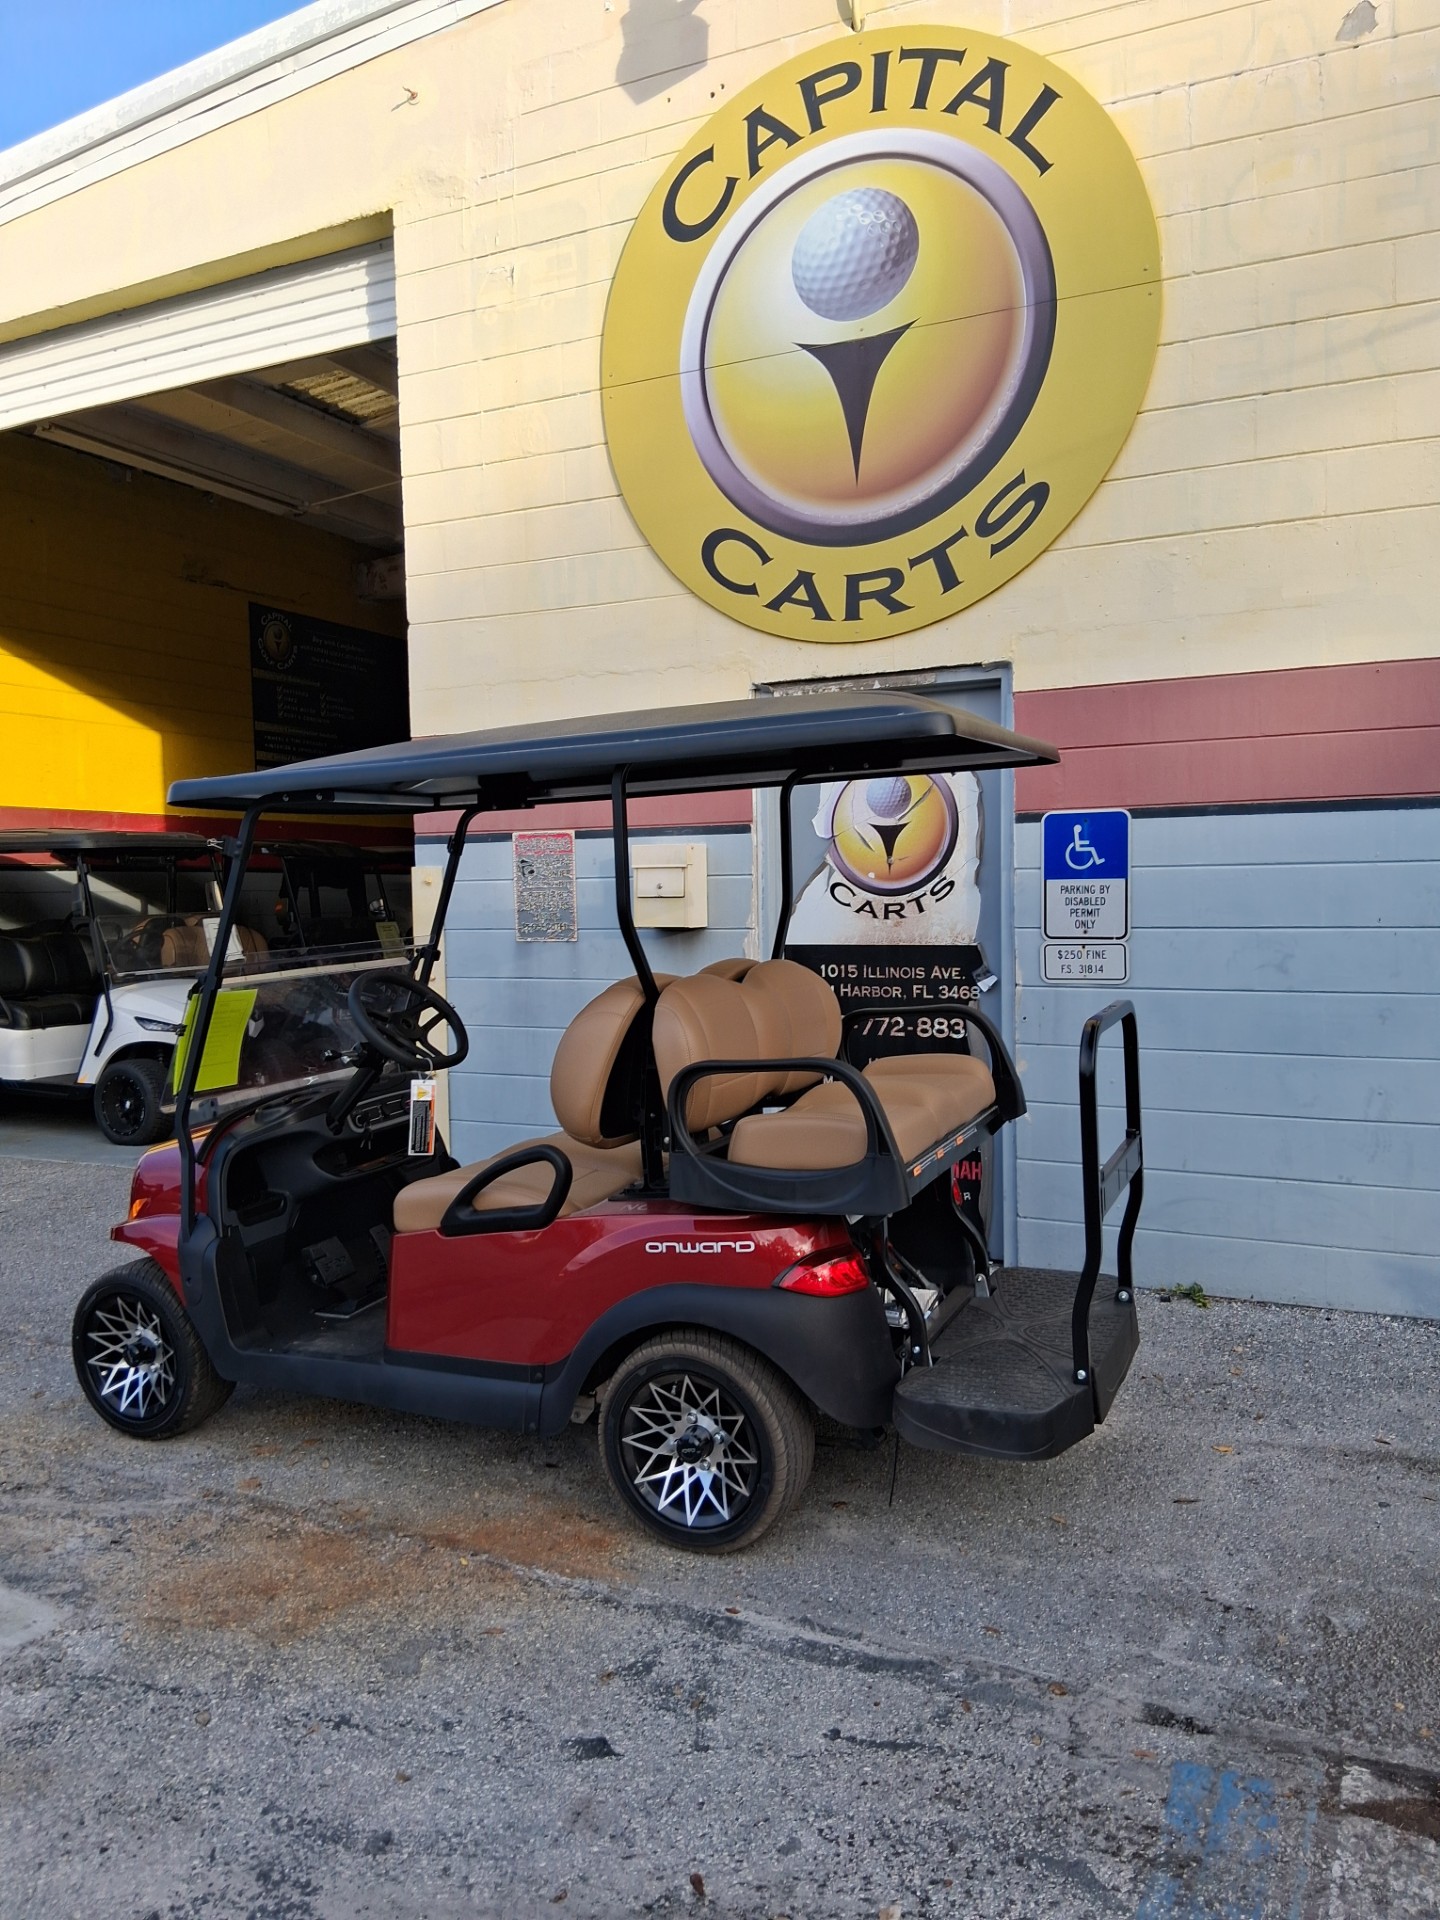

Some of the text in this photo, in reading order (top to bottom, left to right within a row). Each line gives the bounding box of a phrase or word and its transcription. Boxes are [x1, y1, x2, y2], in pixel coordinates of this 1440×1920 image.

[662, 45, 1063, 243] CAPITAL
[700, 468, 1051, 622] CARTS
[1060, 884, 1111, 894] PARKING BY
[829, 875, 956, 920] CARTS
[1064, 896, 1106, 906] DISABLED
[1069, 908, 1101, 918] PERMIT
[1074, 920, 1096, 929] ONLY
[1057, 950, 1107, 960] $250 FINE
[820, 963, 966, 980] 1015 ILLINOIS AVE.
[839, 983, 907, 1000] HARBOR,
[912, 984, 934, 999] FL
